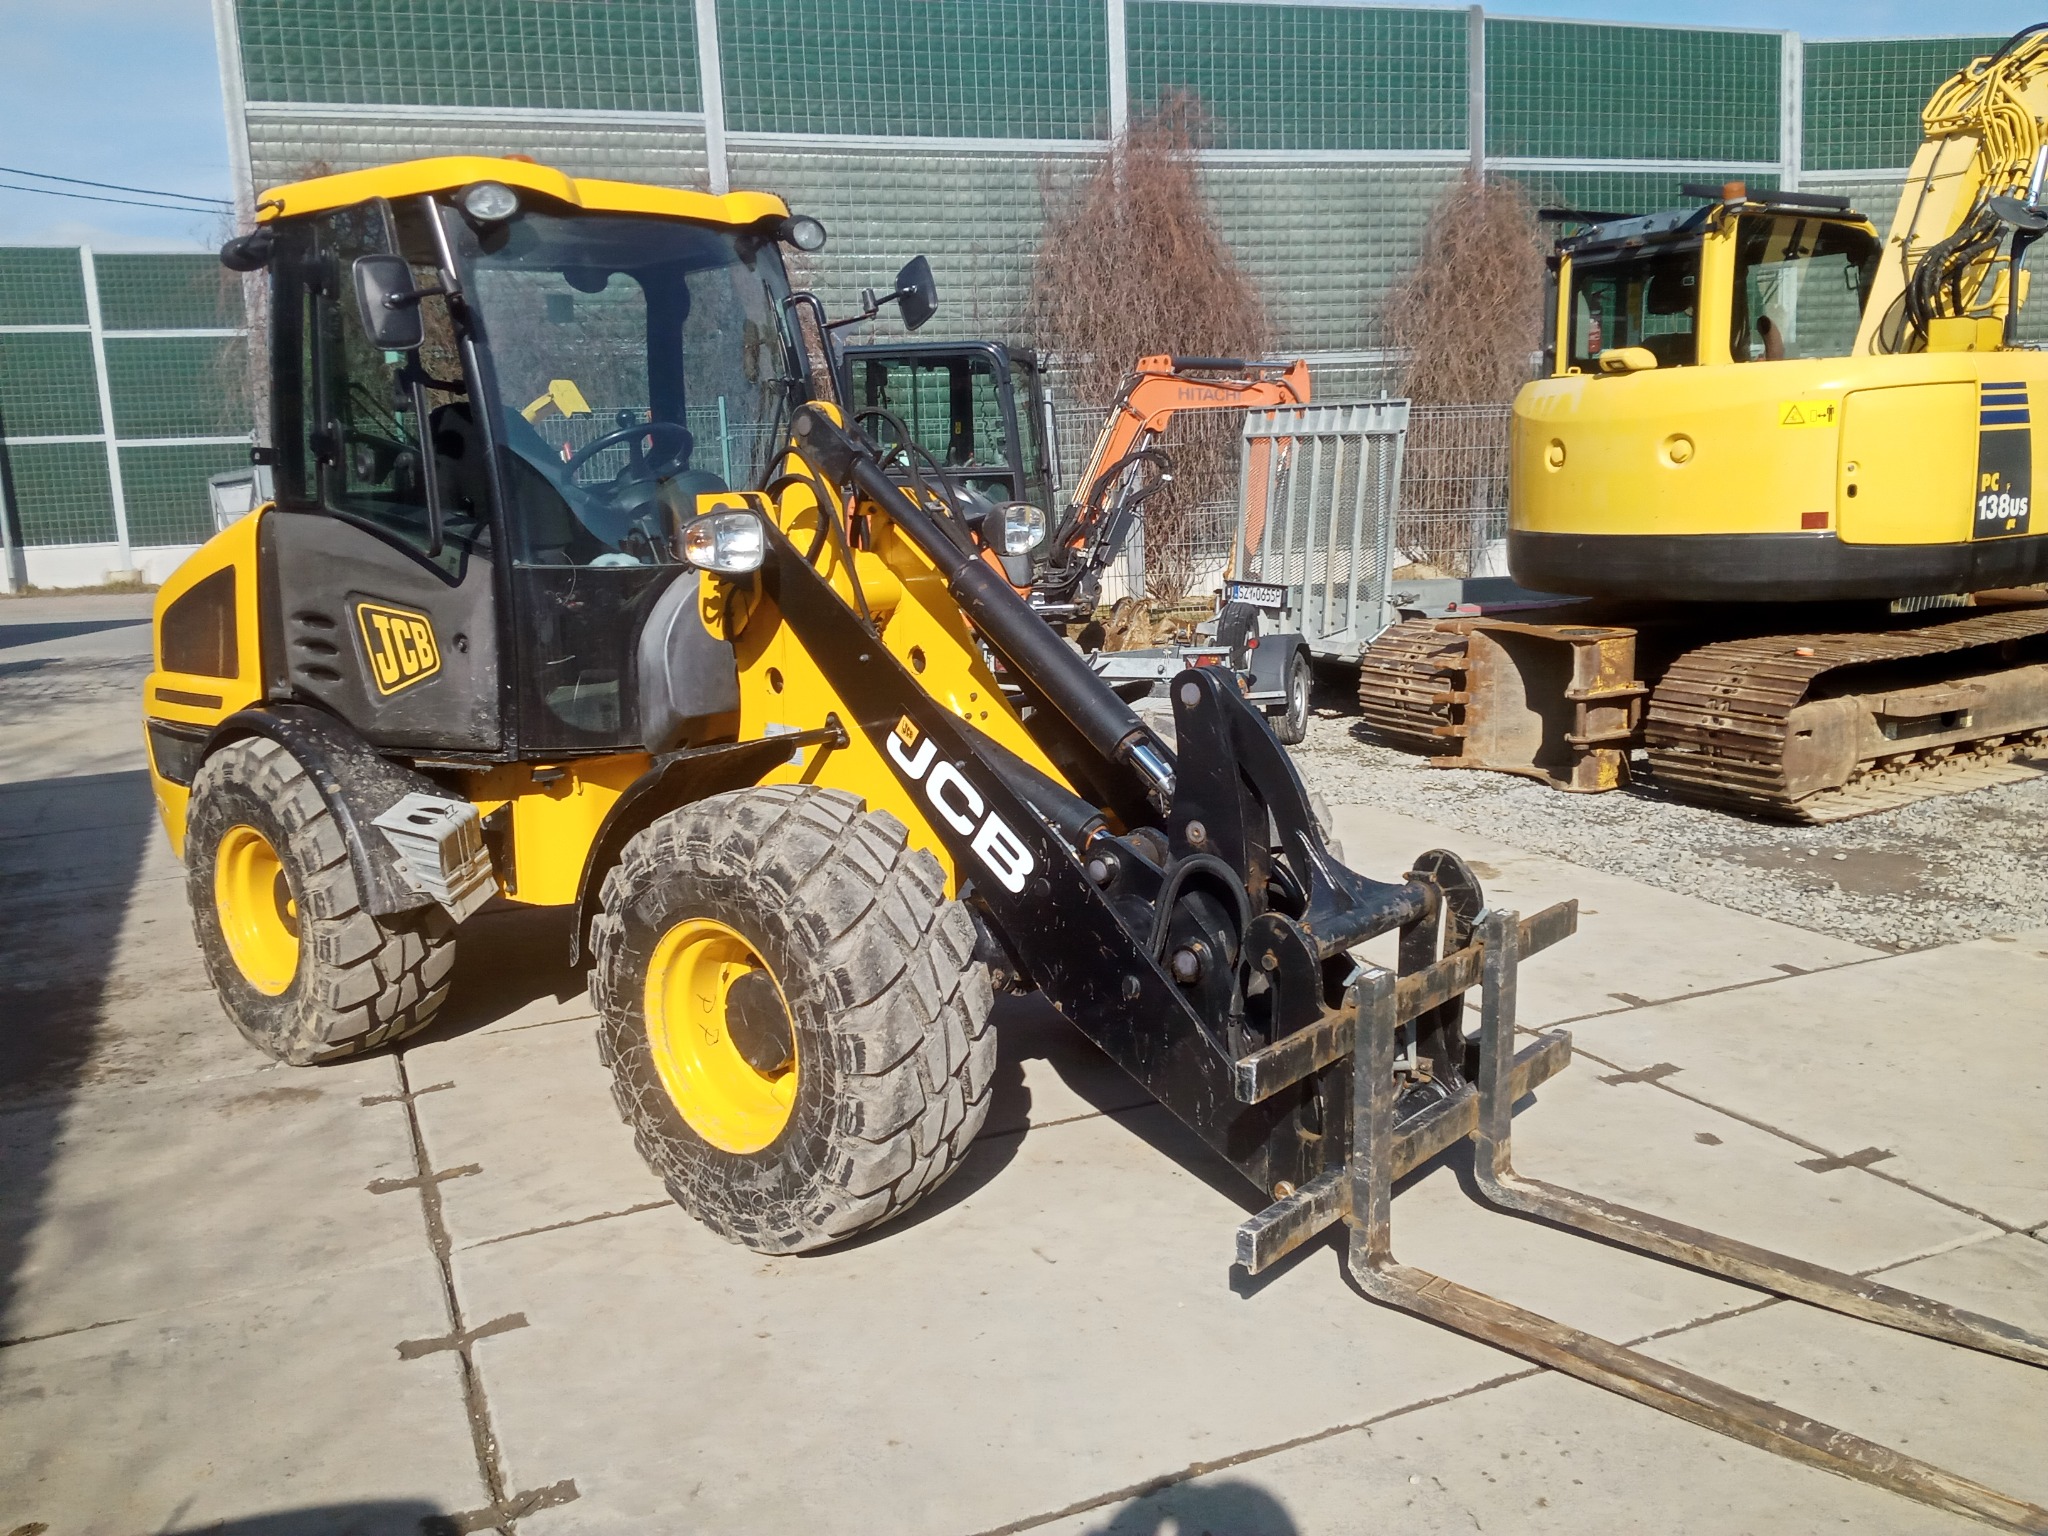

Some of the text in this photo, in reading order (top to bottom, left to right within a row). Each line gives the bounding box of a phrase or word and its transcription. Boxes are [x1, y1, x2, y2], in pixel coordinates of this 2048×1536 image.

[1178, 387, 1242, 401] HITACHI
[1981, 472, 2000, 492] PC
[372, 613, 436, 684] JCB
[886, 730, 1034, 894] JCB
